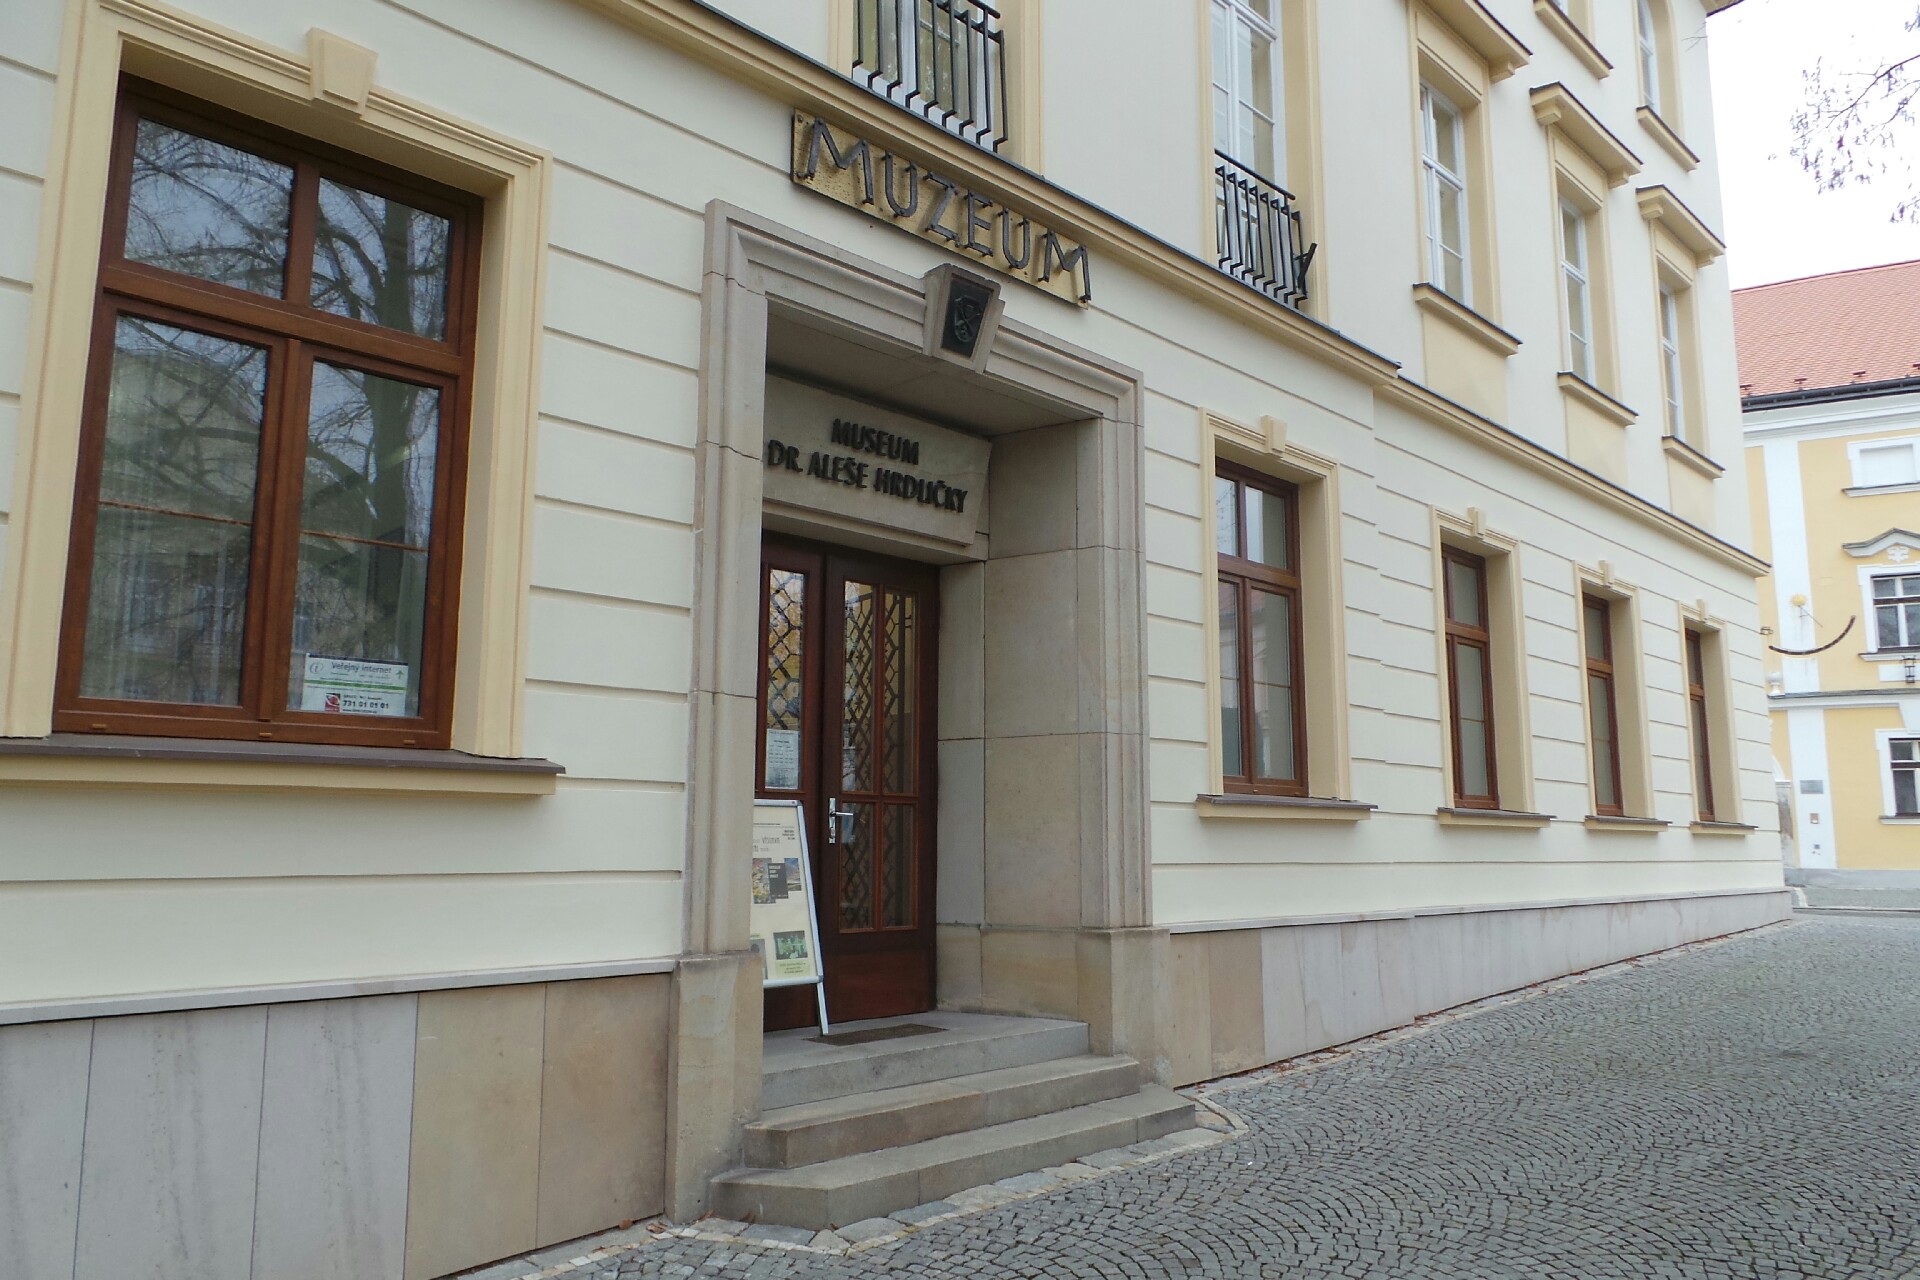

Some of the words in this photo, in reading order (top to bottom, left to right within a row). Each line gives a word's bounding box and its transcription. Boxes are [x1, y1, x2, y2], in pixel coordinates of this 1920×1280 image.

[807, 117, 1091, 302] MUZEUM
[831, 418, 920, 465] MUSEUM
[807, 451, 869, 489] ALEŠE
[874, 467, 969, 513] HRDLIČKY
[361, 664, 392, 674] internet
